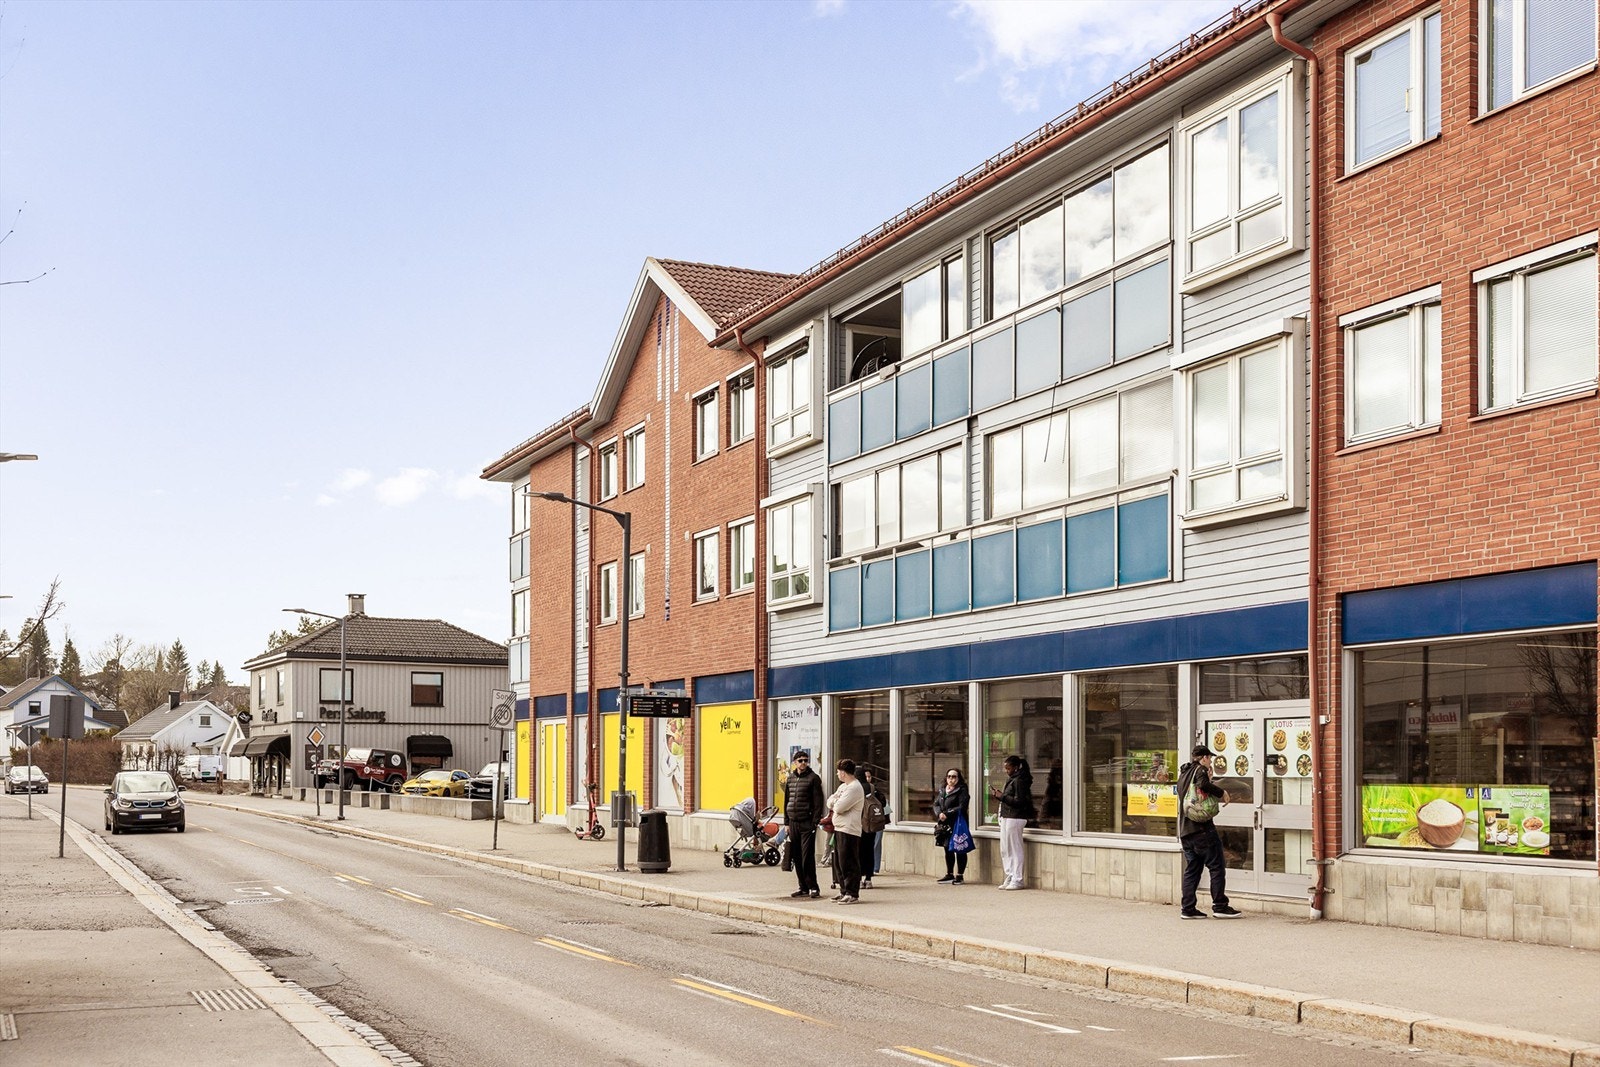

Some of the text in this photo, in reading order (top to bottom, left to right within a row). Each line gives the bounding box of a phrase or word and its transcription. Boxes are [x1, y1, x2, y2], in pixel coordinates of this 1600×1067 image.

[347, 707, 387, 723] Salong
[780, 709, 804, 719] HEALTHY
[780, 722, 798, 731] TASTY
[1215, 722, 1232, 730] LOTUS
[1275, 720, 1293, 728] LOTUS
